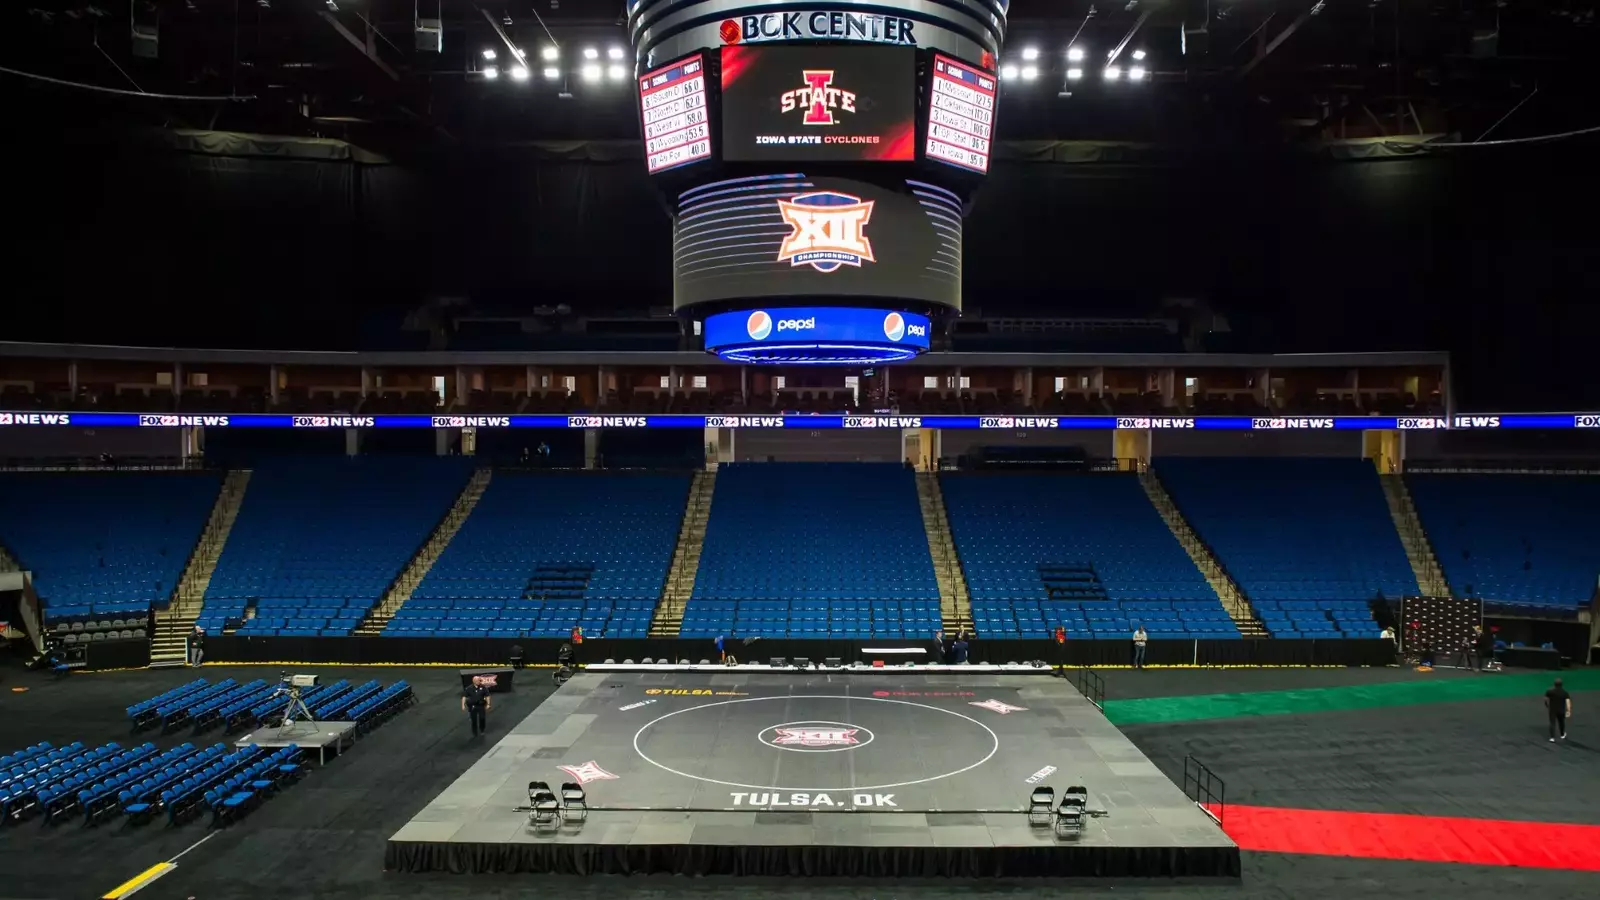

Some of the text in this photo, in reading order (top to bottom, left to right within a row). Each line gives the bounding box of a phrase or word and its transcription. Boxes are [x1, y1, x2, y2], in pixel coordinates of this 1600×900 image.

[808, 12, 917, 44] CENTER
[781, 88, 856, 114] STATE
[936, 95, 940, 105] 2
[934, 110, 938, 120] 3
[648, 127, 652, 137] 8
[933, 126, 937, 136] 4
[650, 143, 654, 152] 9
[688, 126, 703, 140] 53.5
[691, 143, 706, 155] 40.0
[931, 141, 935, 152] 5
[784, 206, 868, 254] XII
[798, 252, 855, 260] CHAMPIONSHIP
[778, 317, 815, 332] pepsi
[908, 324, 925, 336] pepsi
[15, 414, 70, 424] NEWS
[180, 416, 228, 426] NEWS
[331, 417, 374, 426] NEWS
[467, 417, 510, 427] NEWS
[604, 418, 646, 427] NEWS
[741, 418, 784, 427] NEWS
[878, 418, 921, 427] NEWS
[1015, 418, 1058, 428] NEWS
[1152, 418, 1194, 428] NEWS
[1287, 418, 1334, 428] NEWS
[854, 794, 898, 806] OK
